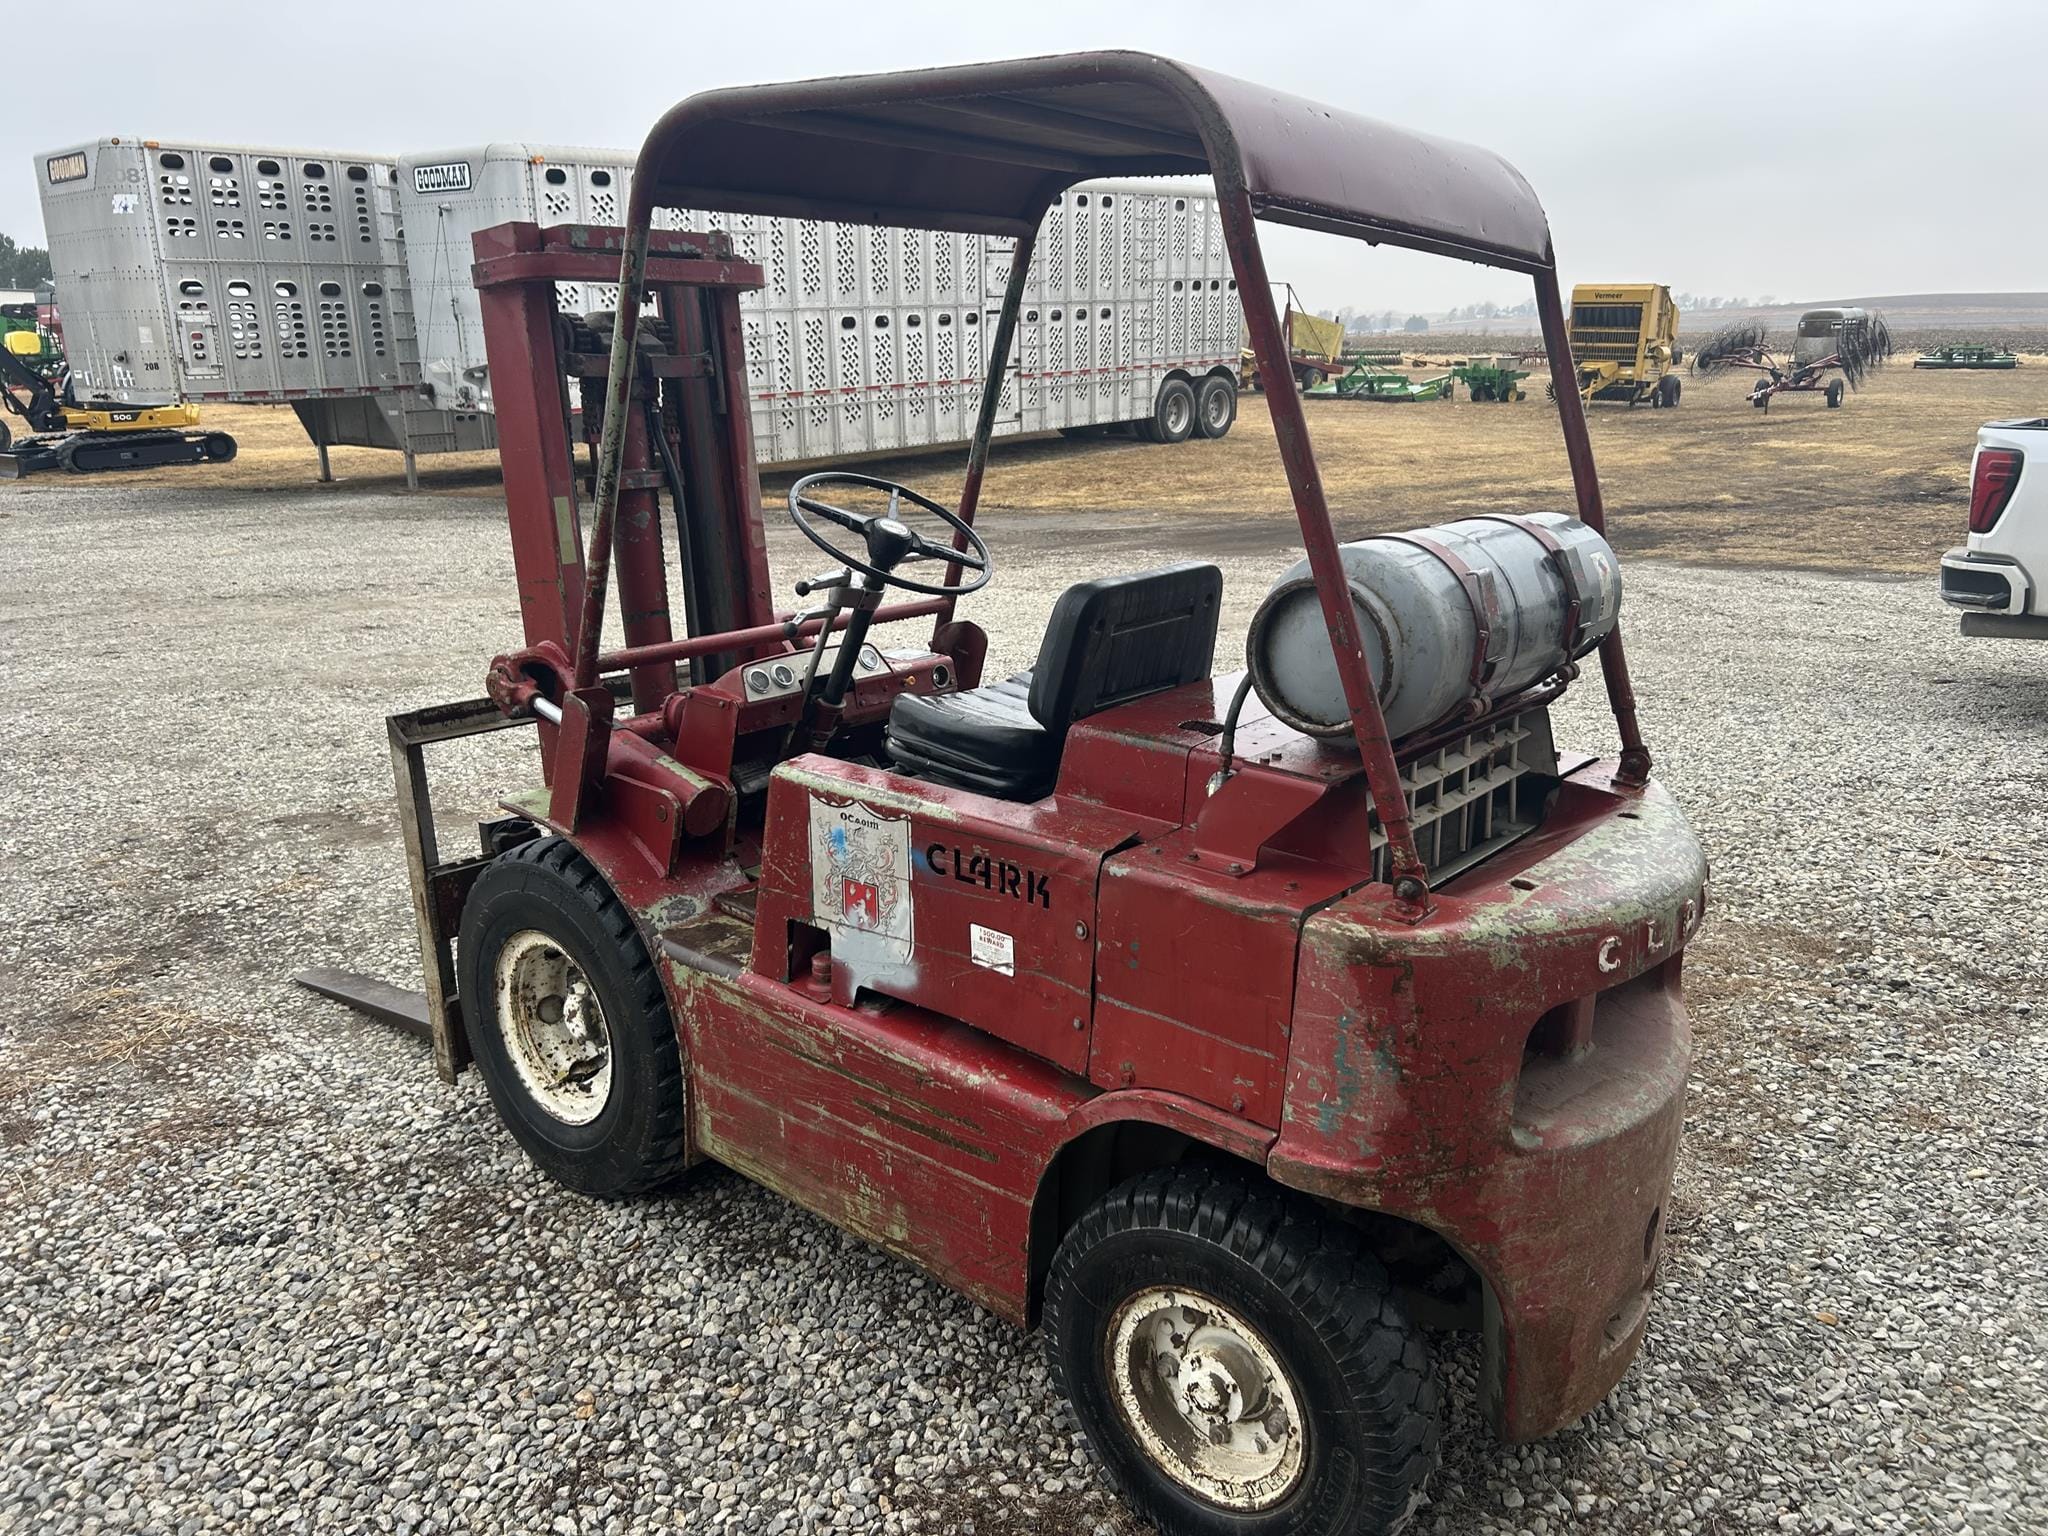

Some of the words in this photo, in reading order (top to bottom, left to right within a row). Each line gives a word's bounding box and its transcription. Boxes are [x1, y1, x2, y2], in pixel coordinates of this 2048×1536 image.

[49, 153, 86, 181] GOODMAN
[104, 168, 140, 184] 08
[416, 165, 467, 189] GOODMAN
[144, 362, 160, 371] 208
[926, 843, 1050, 909] CLARK
